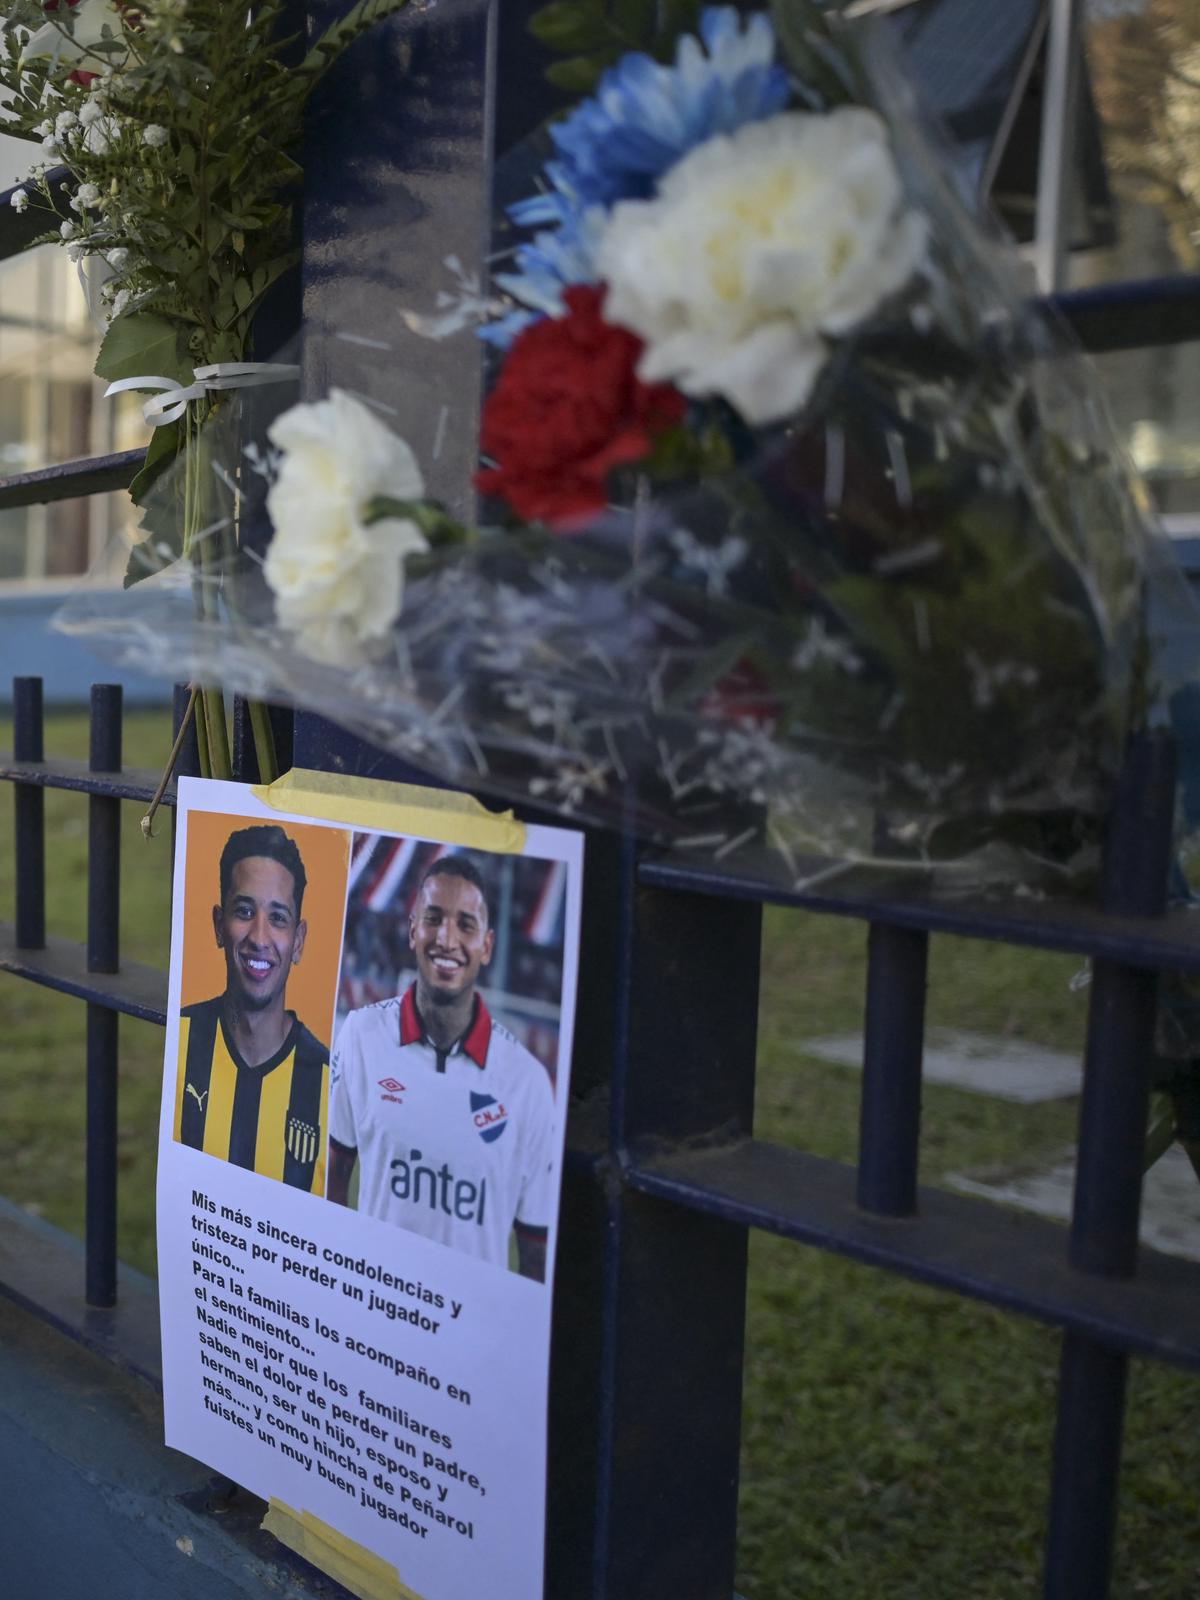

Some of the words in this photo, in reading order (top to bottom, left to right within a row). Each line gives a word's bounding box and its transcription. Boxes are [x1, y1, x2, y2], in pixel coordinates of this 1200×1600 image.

[192, 1190, 216, 1214] Mis
[221, 1206, 252, 1228] más
[257, 1220, 317, 1256] sincera
[323, 1248, 444, 1308] condolencias
[451, 1300, 462, 1319] y
[390, 1150, 486, 1226] antel
[192, 1215, 247, 1251] tristeza
[252, 1244, 278, 1264] por
[282, 1256, 337, 1289] perder
[342, 1282, 363, 1302] un
[368, 1290, 440, 1334] jugador
[193, 1260, 225, 1288] Para
[230, 1278, 243, 1298] la
[247, 1286, 310, 1328] familias
[316, 1318, 339, 1343] los
[345, 1337, 440, 1390] acompaño
[447, 1384, 470, 1405] en
[194, 1287, 207, 1302] el
[197, 1305, 237, 1339] Nadie
[242, 1333, 284, 1363] mejor
[289, 1358, 318, 1382] que
[324, 1371, 348, 1397] los
[358, 1390, 452, 1449] familiares
[199, 1332, 240, 1363] saben
[245, 1358, 258, 1373] el
[263, 1365, 302, 1396] dolor
[307, 1389, 326, 1409] de
[332, 1404, 388, 1442] perder
[394, 1437, 416, 1458] un
[423, 1452, 485, 1496] padre,
[201, 1350, 268, 1403] hermano,
[272, 1394, 297, 1415] ser
[302, 1410, 320, 1430] un
[325, 1420, 360, 1456] hijo,
[366, 1448, 431, 1490] esposo
[437, 1484, 448, 1502] y
[204, 1395, 254, 1434] fuistes
[258, 1429, 276, 1448] un
[281, 1442, 312, 1471] muy
[317, 1460, 355, 1497] buen
[361, 1488, 428, 1538] jugador
[253, 1404, 261, 1420] y
[266, 1413, 308, 1444] como
[313, 1436, 367, 1480] hincha
[373, 1474, 394, 1495] de
[400, 1486, 472, 1539] Peñarol
